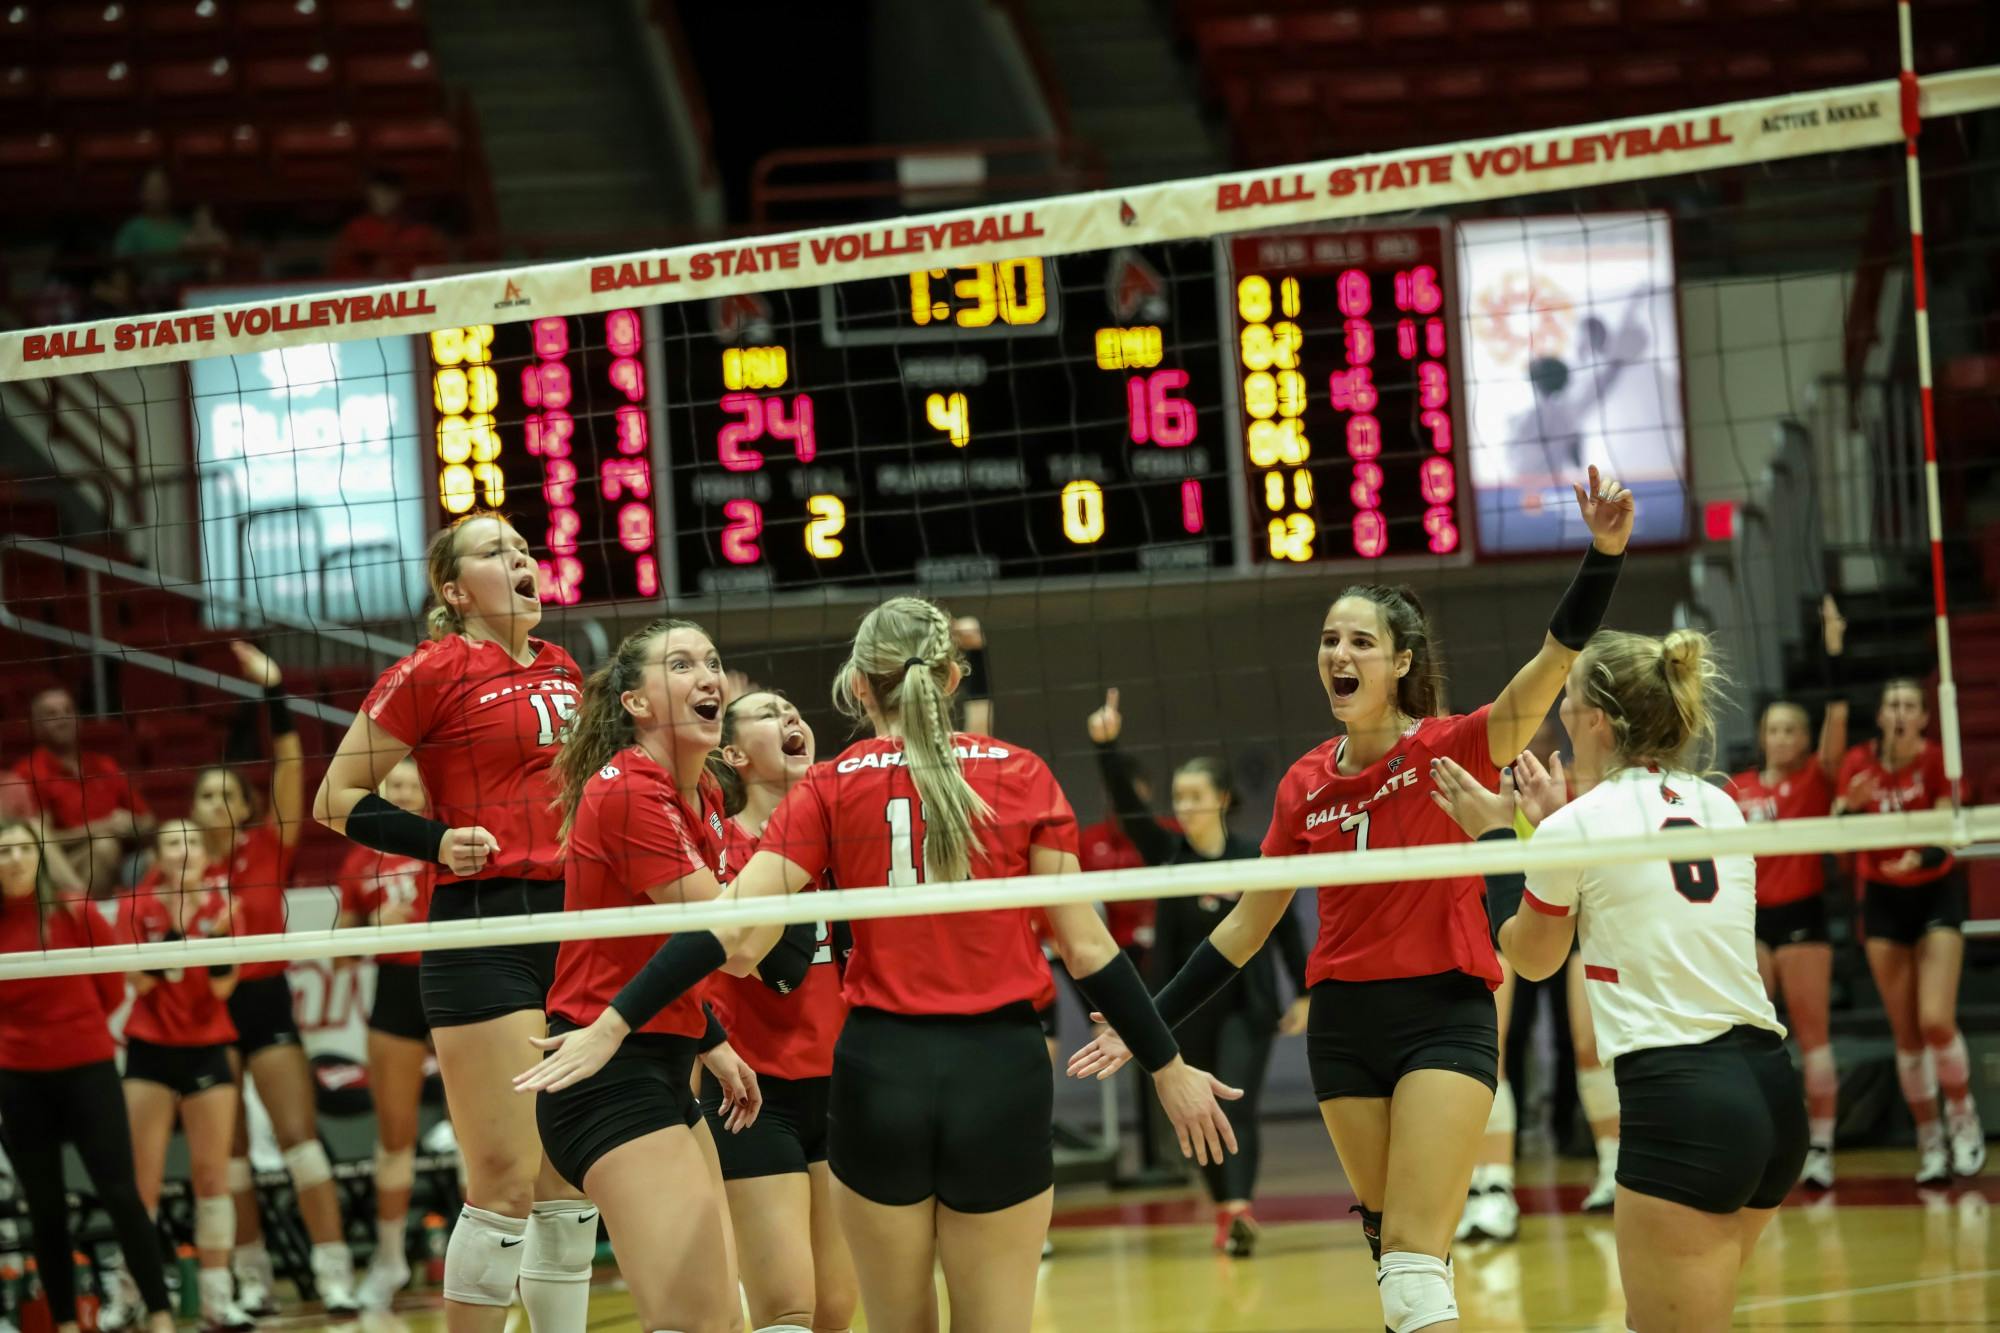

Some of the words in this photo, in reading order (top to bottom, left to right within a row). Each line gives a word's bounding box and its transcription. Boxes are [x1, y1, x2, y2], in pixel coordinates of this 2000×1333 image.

[1761, 109, 1820, 133] ACTIVE
[1826, 101, 1880, 123] ANKLE
[1216, 175, 1315, 212] BALL
[1328, 155, 1452, 197] STATE
[1466, 116, 1733, 178] VOLLEYBALL
[590, 258, 679, 293] BALL
[689, 240, 801, 281] STATE
[810, 211, 1044, 266] VOLLEYBALL
[909, 256, 1047, 328] 1:30
[23, 329, 105, 362] BALL
[114, 315, 214, 351] STATE
[224, 289, 437, 338] VOLLEYBALL
[717, 392, 817, 472] 24
[926, 392, 970, 448] 4
[1127, 369, 1198, 448] 16
[721, 499, 763, 564] 2
[804, 494, 846, 559] 2
[1061, 479, 1105, 544] 0
[1181, 479, 1203, 533] 1
[636, 553, 659, 597] 1
[529, 694, 581, 744] 15
[1306, 803, 1351, 831] BALL
[1340, 811, 1370, 854] 7
